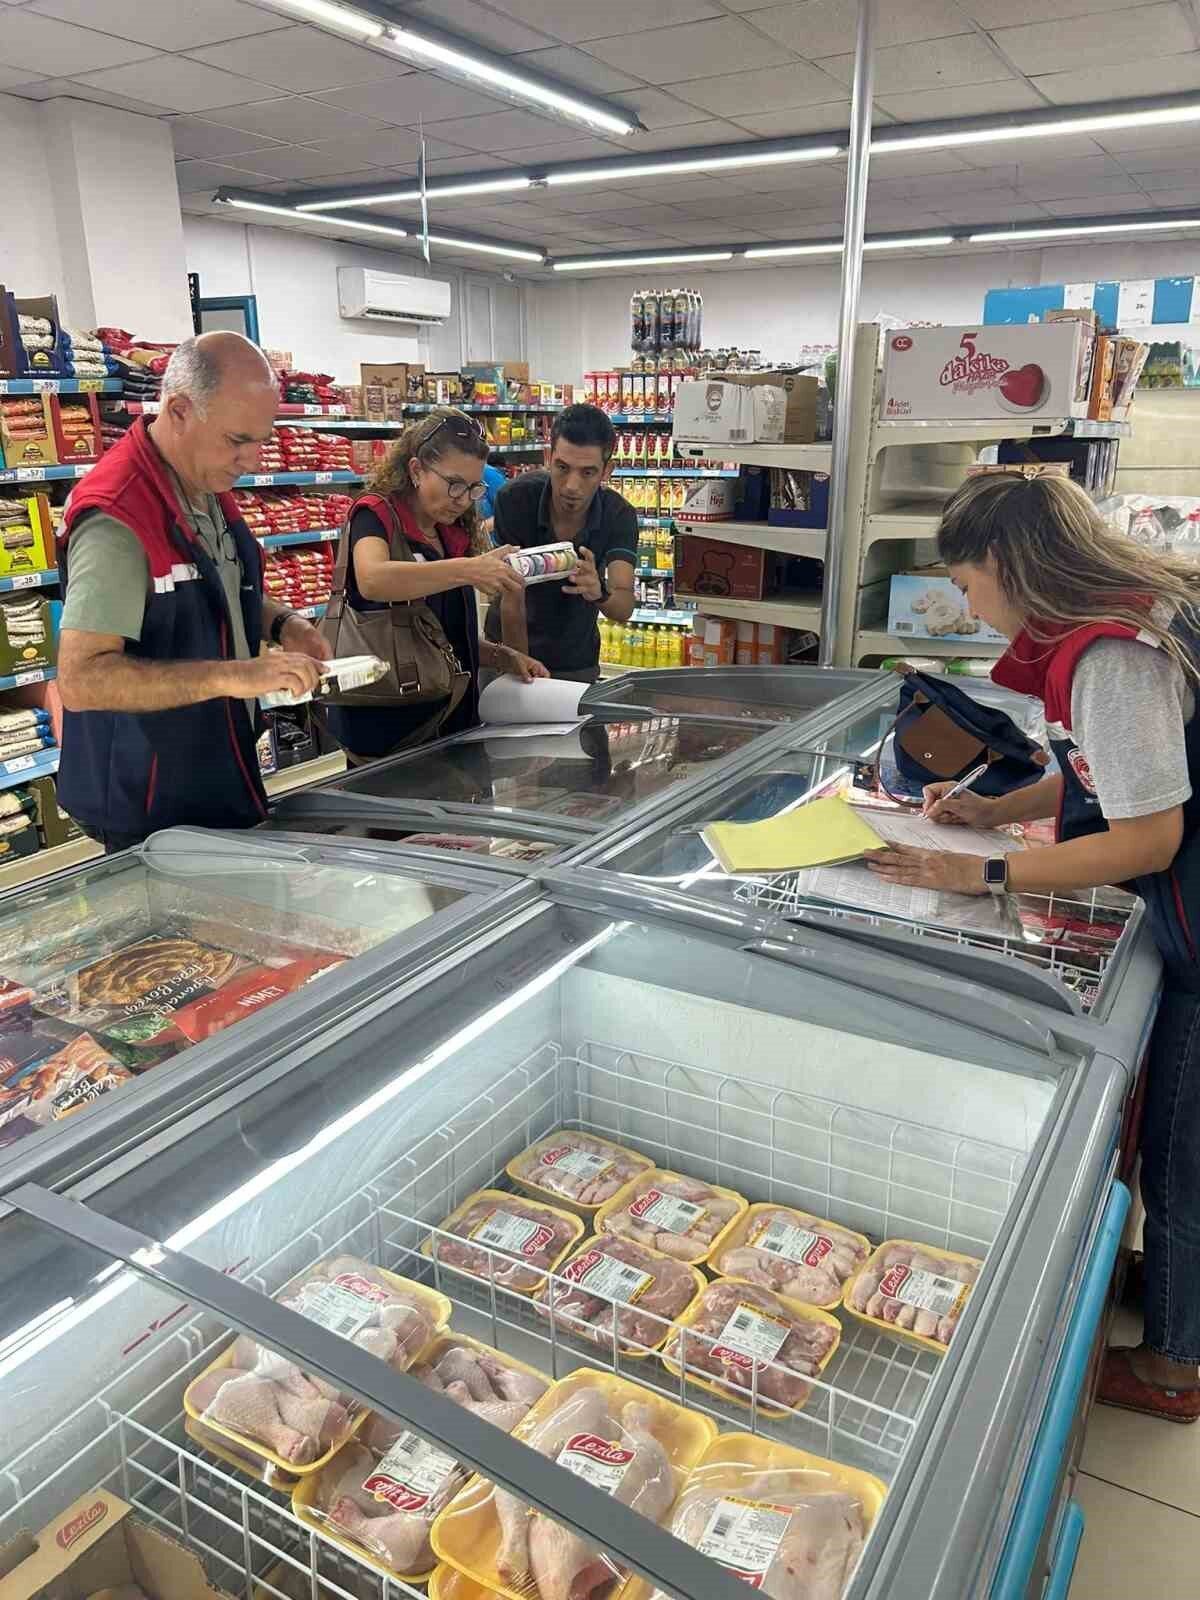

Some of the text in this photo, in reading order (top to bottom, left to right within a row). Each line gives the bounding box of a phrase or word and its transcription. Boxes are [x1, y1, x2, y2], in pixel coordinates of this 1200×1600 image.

[960, 333, 977, 360] 5
[573, 1434, 625, 1460] Lezita
[373, 1480, 423, 1509] Lezita
